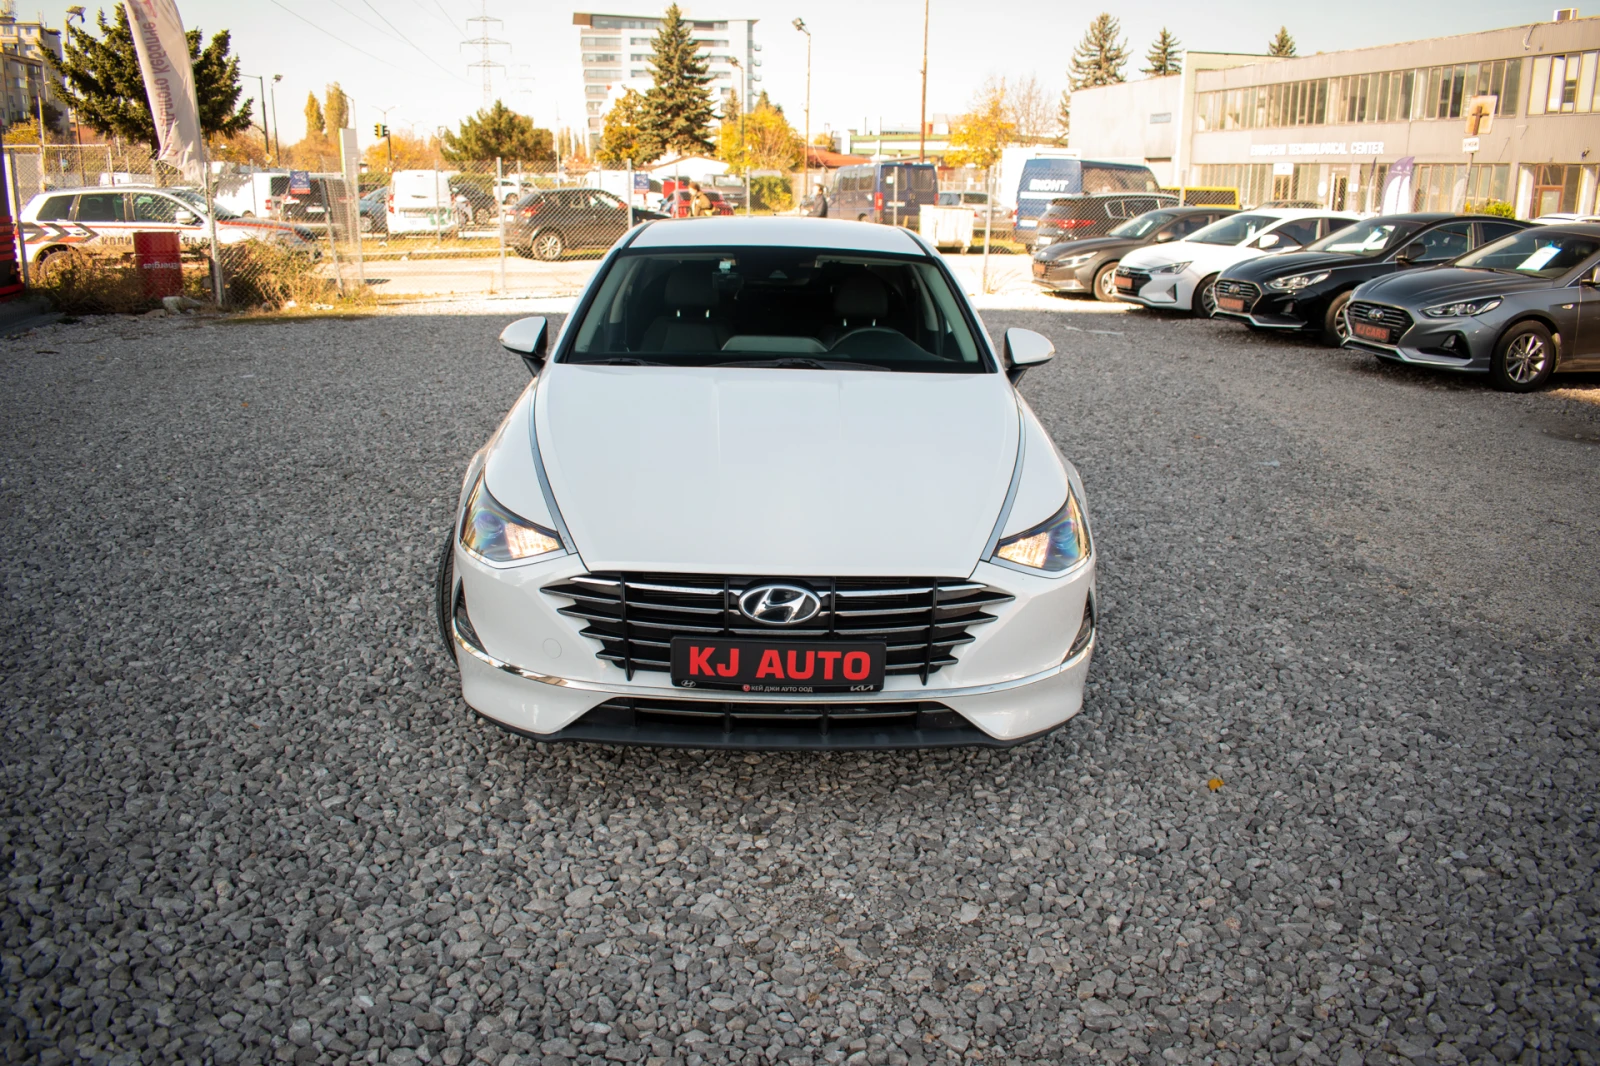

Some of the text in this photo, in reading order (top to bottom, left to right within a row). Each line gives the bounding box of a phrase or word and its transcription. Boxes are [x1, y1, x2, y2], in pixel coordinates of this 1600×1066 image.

[1350, 141, 1385, 155] CENTER
[1365, 325, 1387, 339] CARS
[689, 646, 871, 681] KJ AUTO
[764, 685, 780, 693] ДЖИ
